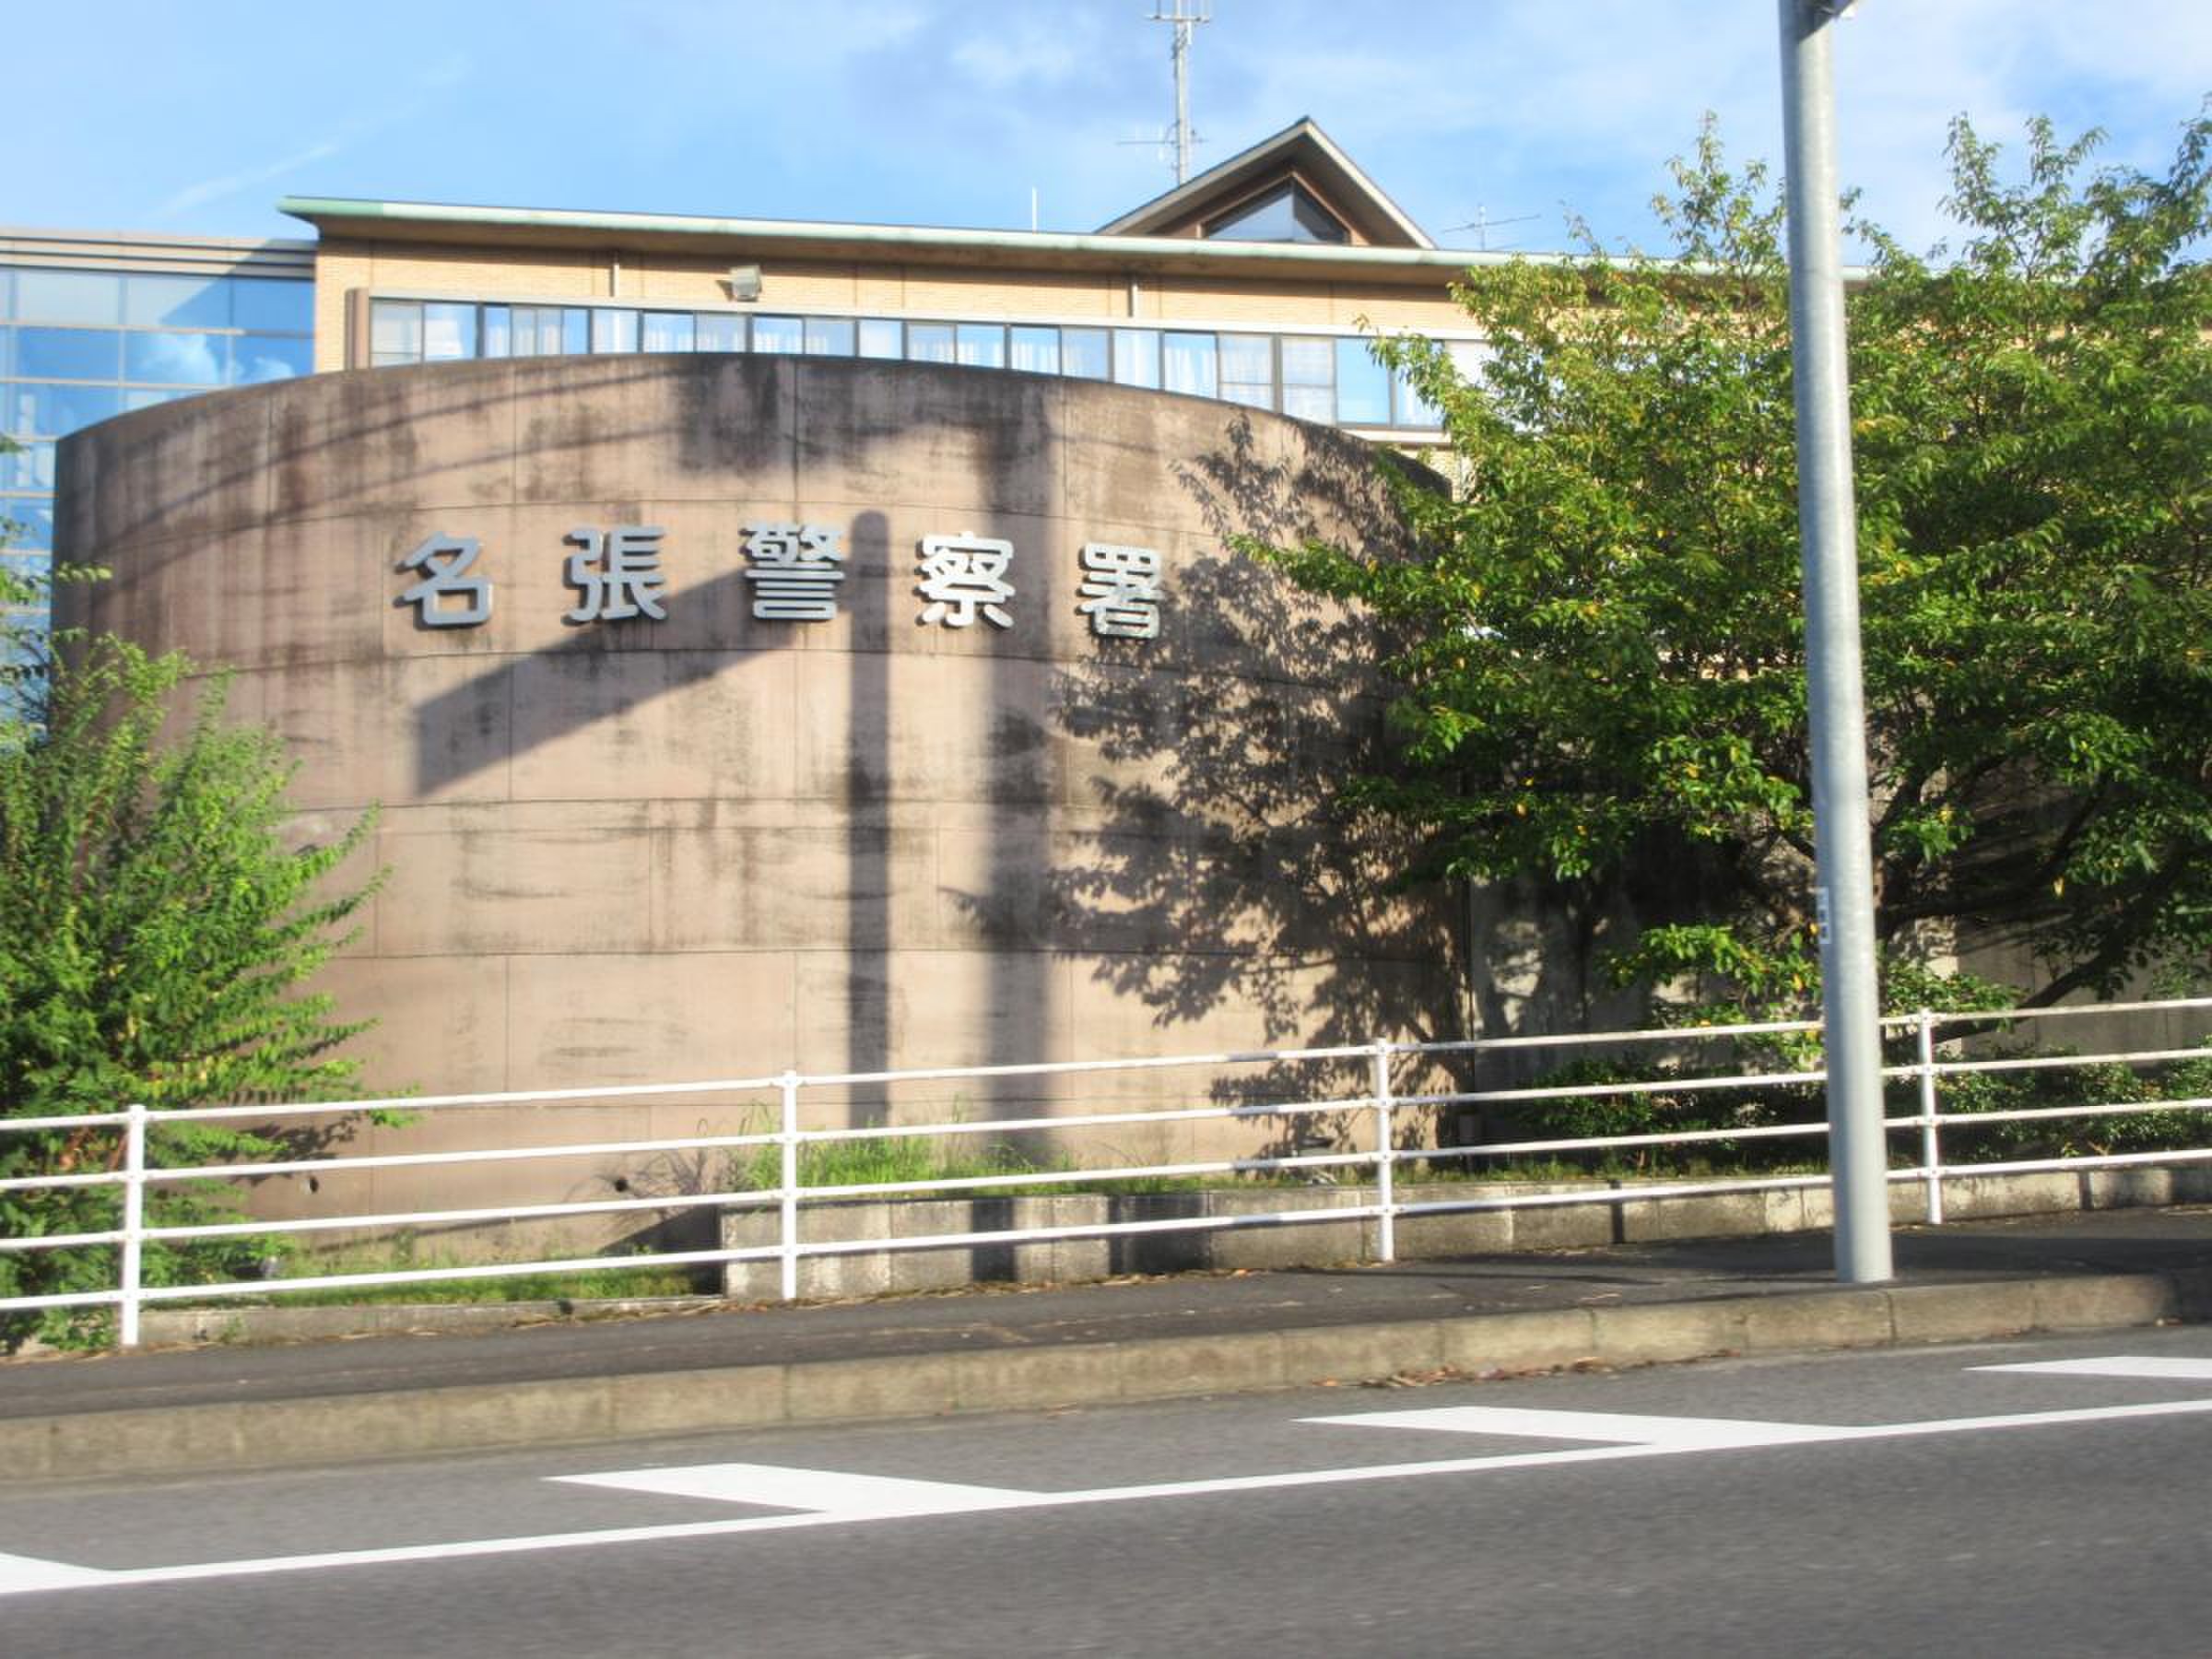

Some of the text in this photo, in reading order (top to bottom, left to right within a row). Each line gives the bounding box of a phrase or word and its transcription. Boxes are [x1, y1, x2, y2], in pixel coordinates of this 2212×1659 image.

[396, 522, 1163, 638] 名張警察署
